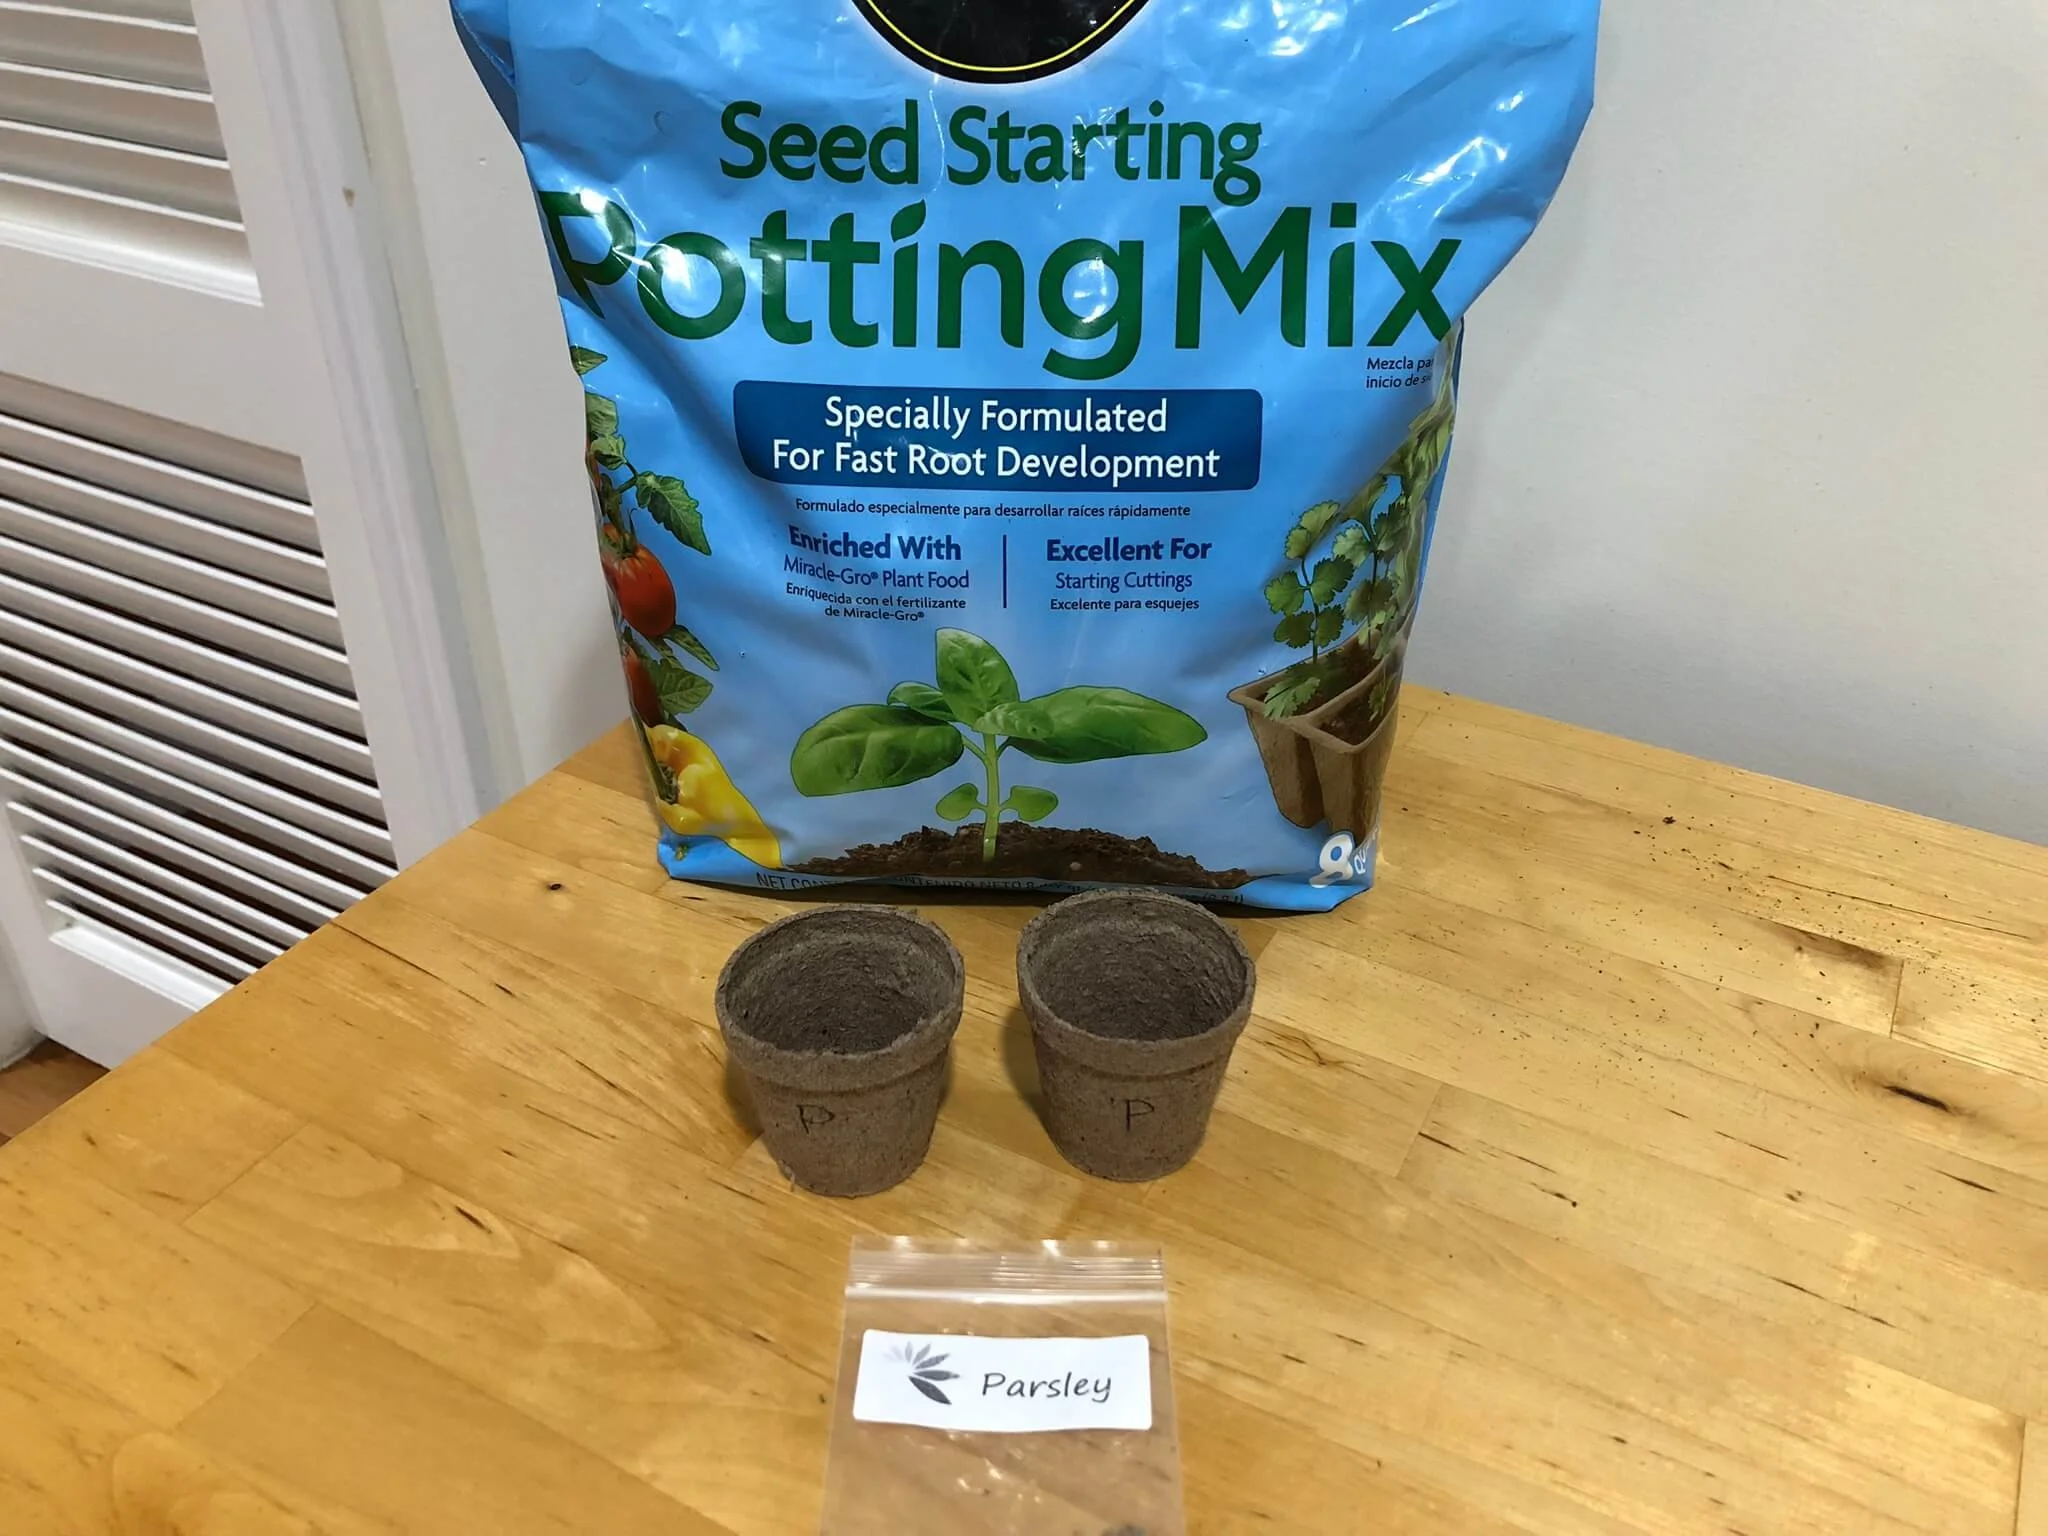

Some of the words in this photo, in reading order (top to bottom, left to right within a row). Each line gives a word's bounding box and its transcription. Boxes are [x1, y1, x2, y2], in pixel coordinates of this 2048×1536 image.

[719, 99, 919, 185] Seed
[946, 100, 1263, 206] Starting
[538, 190, 1145, 381] Potting
[1174, 203, 1463, 350] Mix
[1366, 356, 1413, 370] Mezcla
[1365, 375, 1401, 389] inicio
[1405, 374, 1419, 387] de
[825, 396, 971, 440] Specially
[981, 397, 1167, 432] Formulated
[773, 438, 825, 471] For
[835, 442, 898, 473] Fast
[908, 443, 987, 476] Root
[997, 444, 1221, 488] Development
[796, 498, 865, 513] Formulado
[868, 501, 960, 517] especialmente
[963, 506, 991, 519] para
[994, 503, 1064, 517] desarrollar
[1068, 504, 1105, 517] raíces
[1108, 504, 1191, 520] rápidamente
[788, 524, 891, 559] Enriched
[897, 534, 962, 560] With
[1047, 536, 1164, 562] Excellent
[1170, 537, 1212, 560] For
[883, 569, 924, 588] Plant
[928, 569, 970, 588] Food
[1056, 571, 1120, 593] Starting
[1124, 571, 1193, 592] Cuttings
[786, 582, 852, 604] Enriquecida
[855, 595, 877, 606] con
[882, 594, 894, 606] el
[897, 596, 967, 609] fertilizante
[1050, 598, 1111, 610] Excelente
[1114, 599, 1141, 612] para
[1145, 598, 1200, 612] esquejes
[824, 606, 840, 617] de
[757, 871, 785, 889] NET
[795, 1104, 835, 1134] P
[1122, 1099, 1155, 1132] P
[982, 1371, 1112, 1403] Parsley
